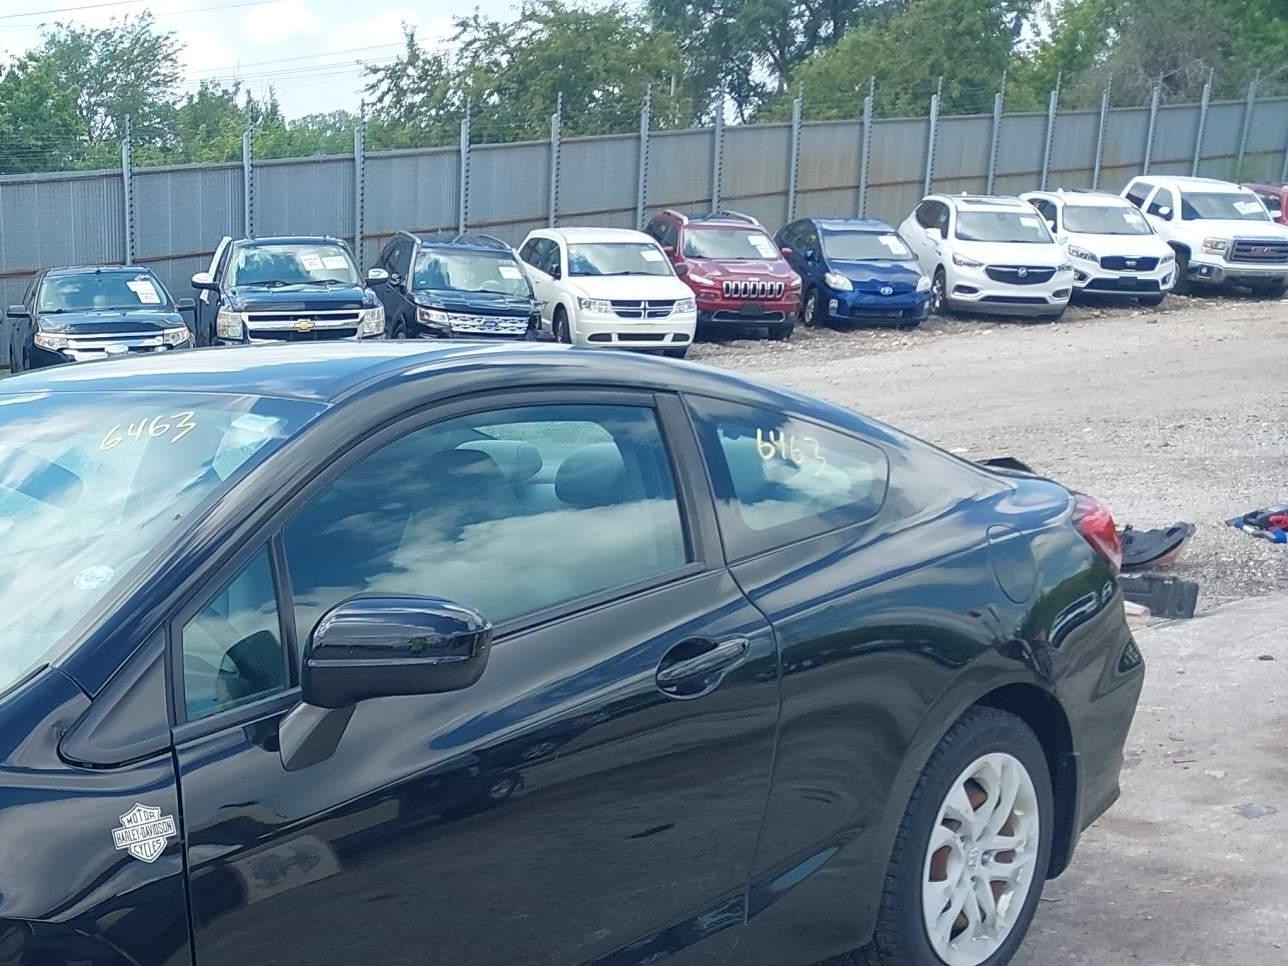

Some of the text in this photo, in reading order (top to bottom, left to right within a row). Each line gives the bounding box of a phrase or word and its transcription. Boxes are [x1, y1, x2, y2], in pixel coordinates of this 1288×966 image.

[99, 410, 196, 450] 6463
[756, 427, 826, 476] 6463
[126, 808, 156, 826] MOTOR
